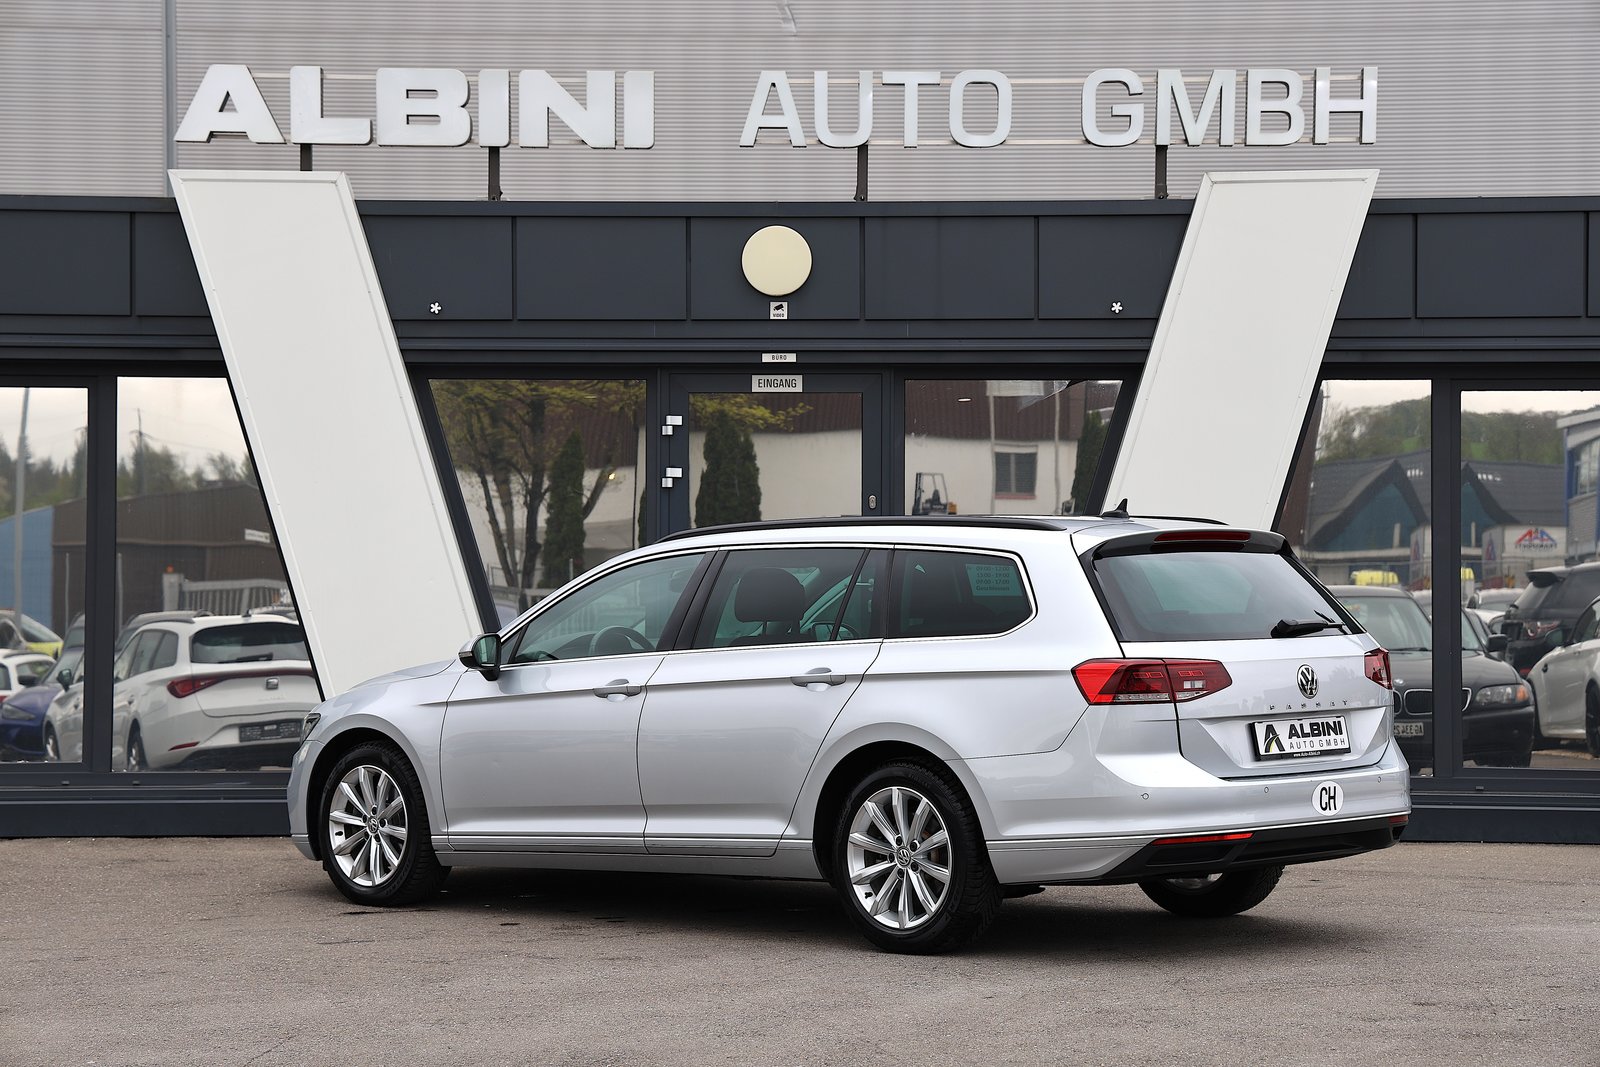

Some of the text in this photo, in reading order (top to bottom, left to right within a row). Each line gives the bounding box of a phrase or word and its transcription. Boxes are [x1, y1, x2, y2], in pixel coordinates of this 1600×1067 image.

[174, 64, 1378, 149] ALBINI AUTO GMBH
[757, 378, 797, 388] EINGANG
[1288, 720, 1344, 739] ALBINI
[1289, 738, 1346, 750] AUTO GMBH
[1319, 786, 1337, 811] CH
